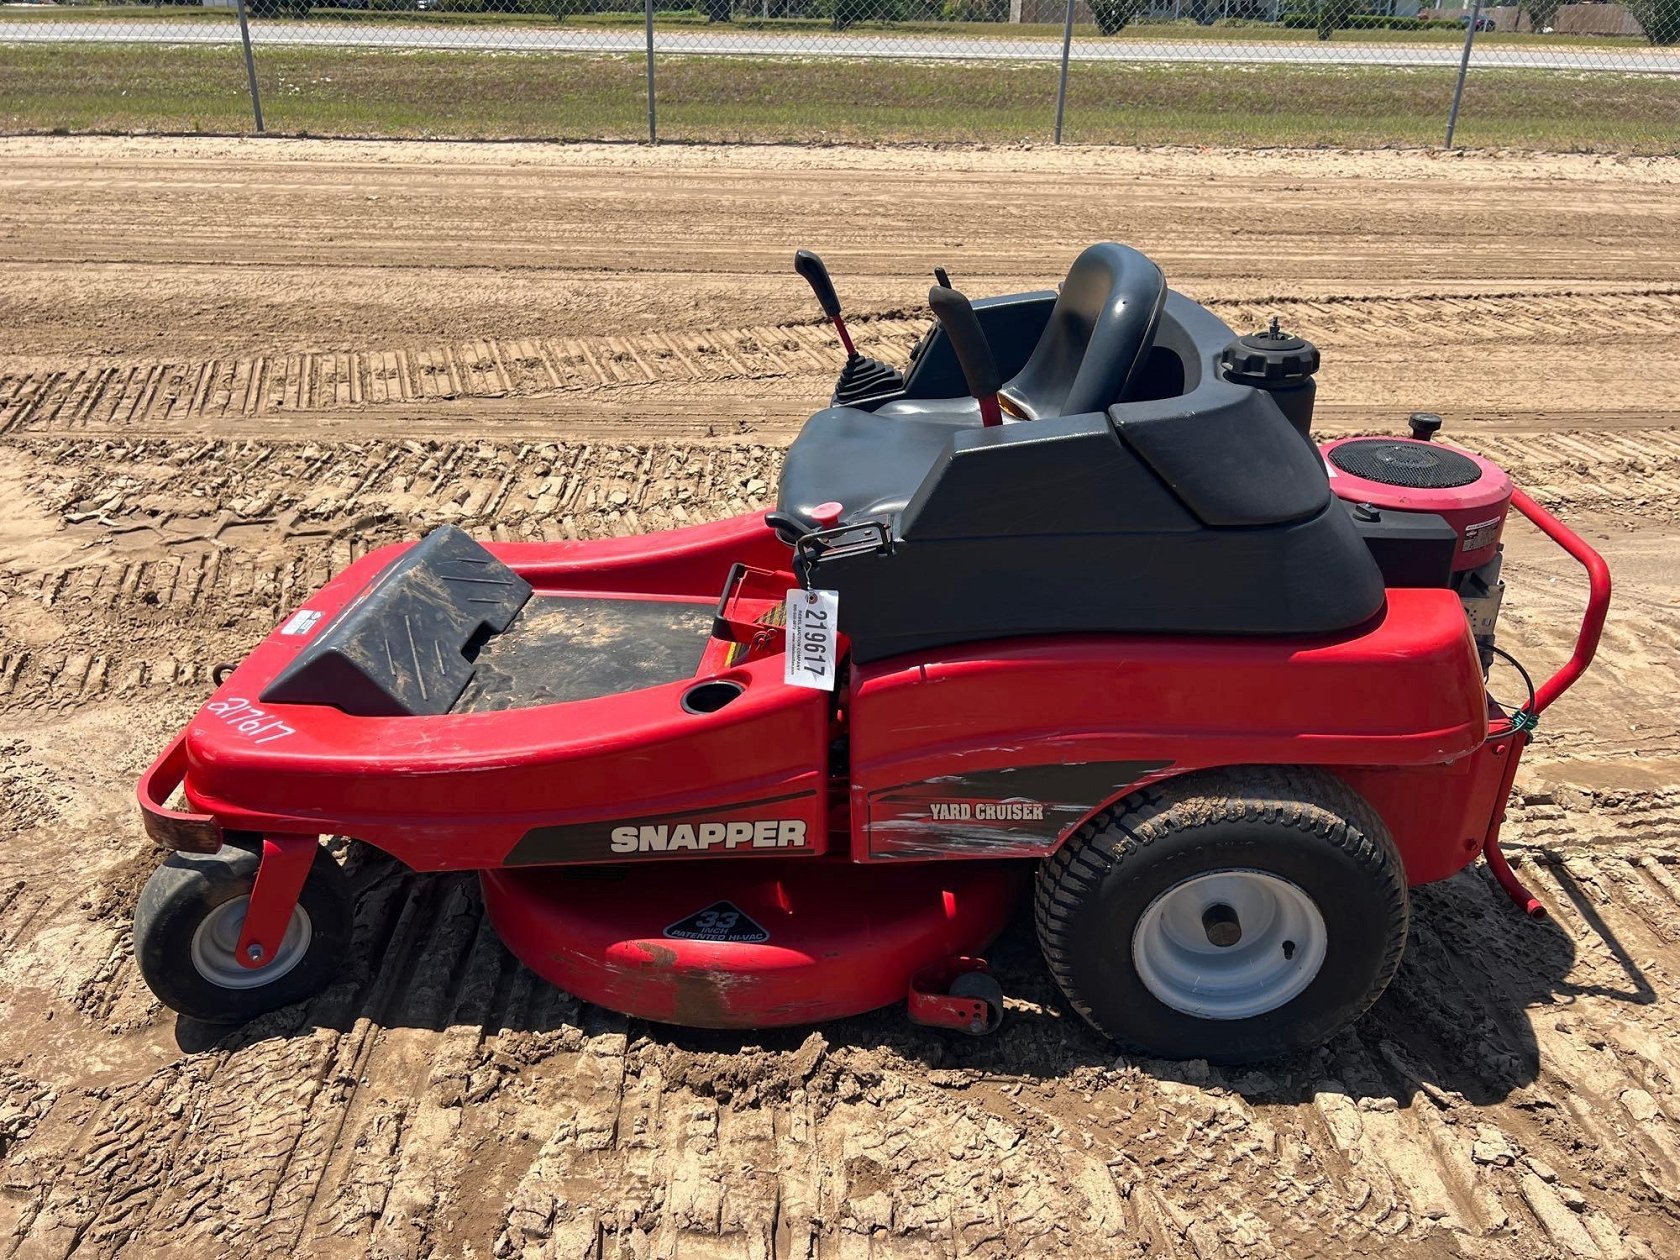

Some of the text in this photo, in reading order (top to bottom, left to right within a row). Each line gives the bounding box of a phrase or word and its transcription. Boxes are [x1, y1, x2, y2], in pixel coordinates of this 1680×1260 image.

[804, 609, 828, 676] 219617
[207, 697, 296, 744] 217617
[930, 803, 1044, 820] YARD CRUISER
[610, 819, 807, 853] SNAPPER
[696, 911, 739, 928] 33
[671, 930, 726, 941] PATENTED
